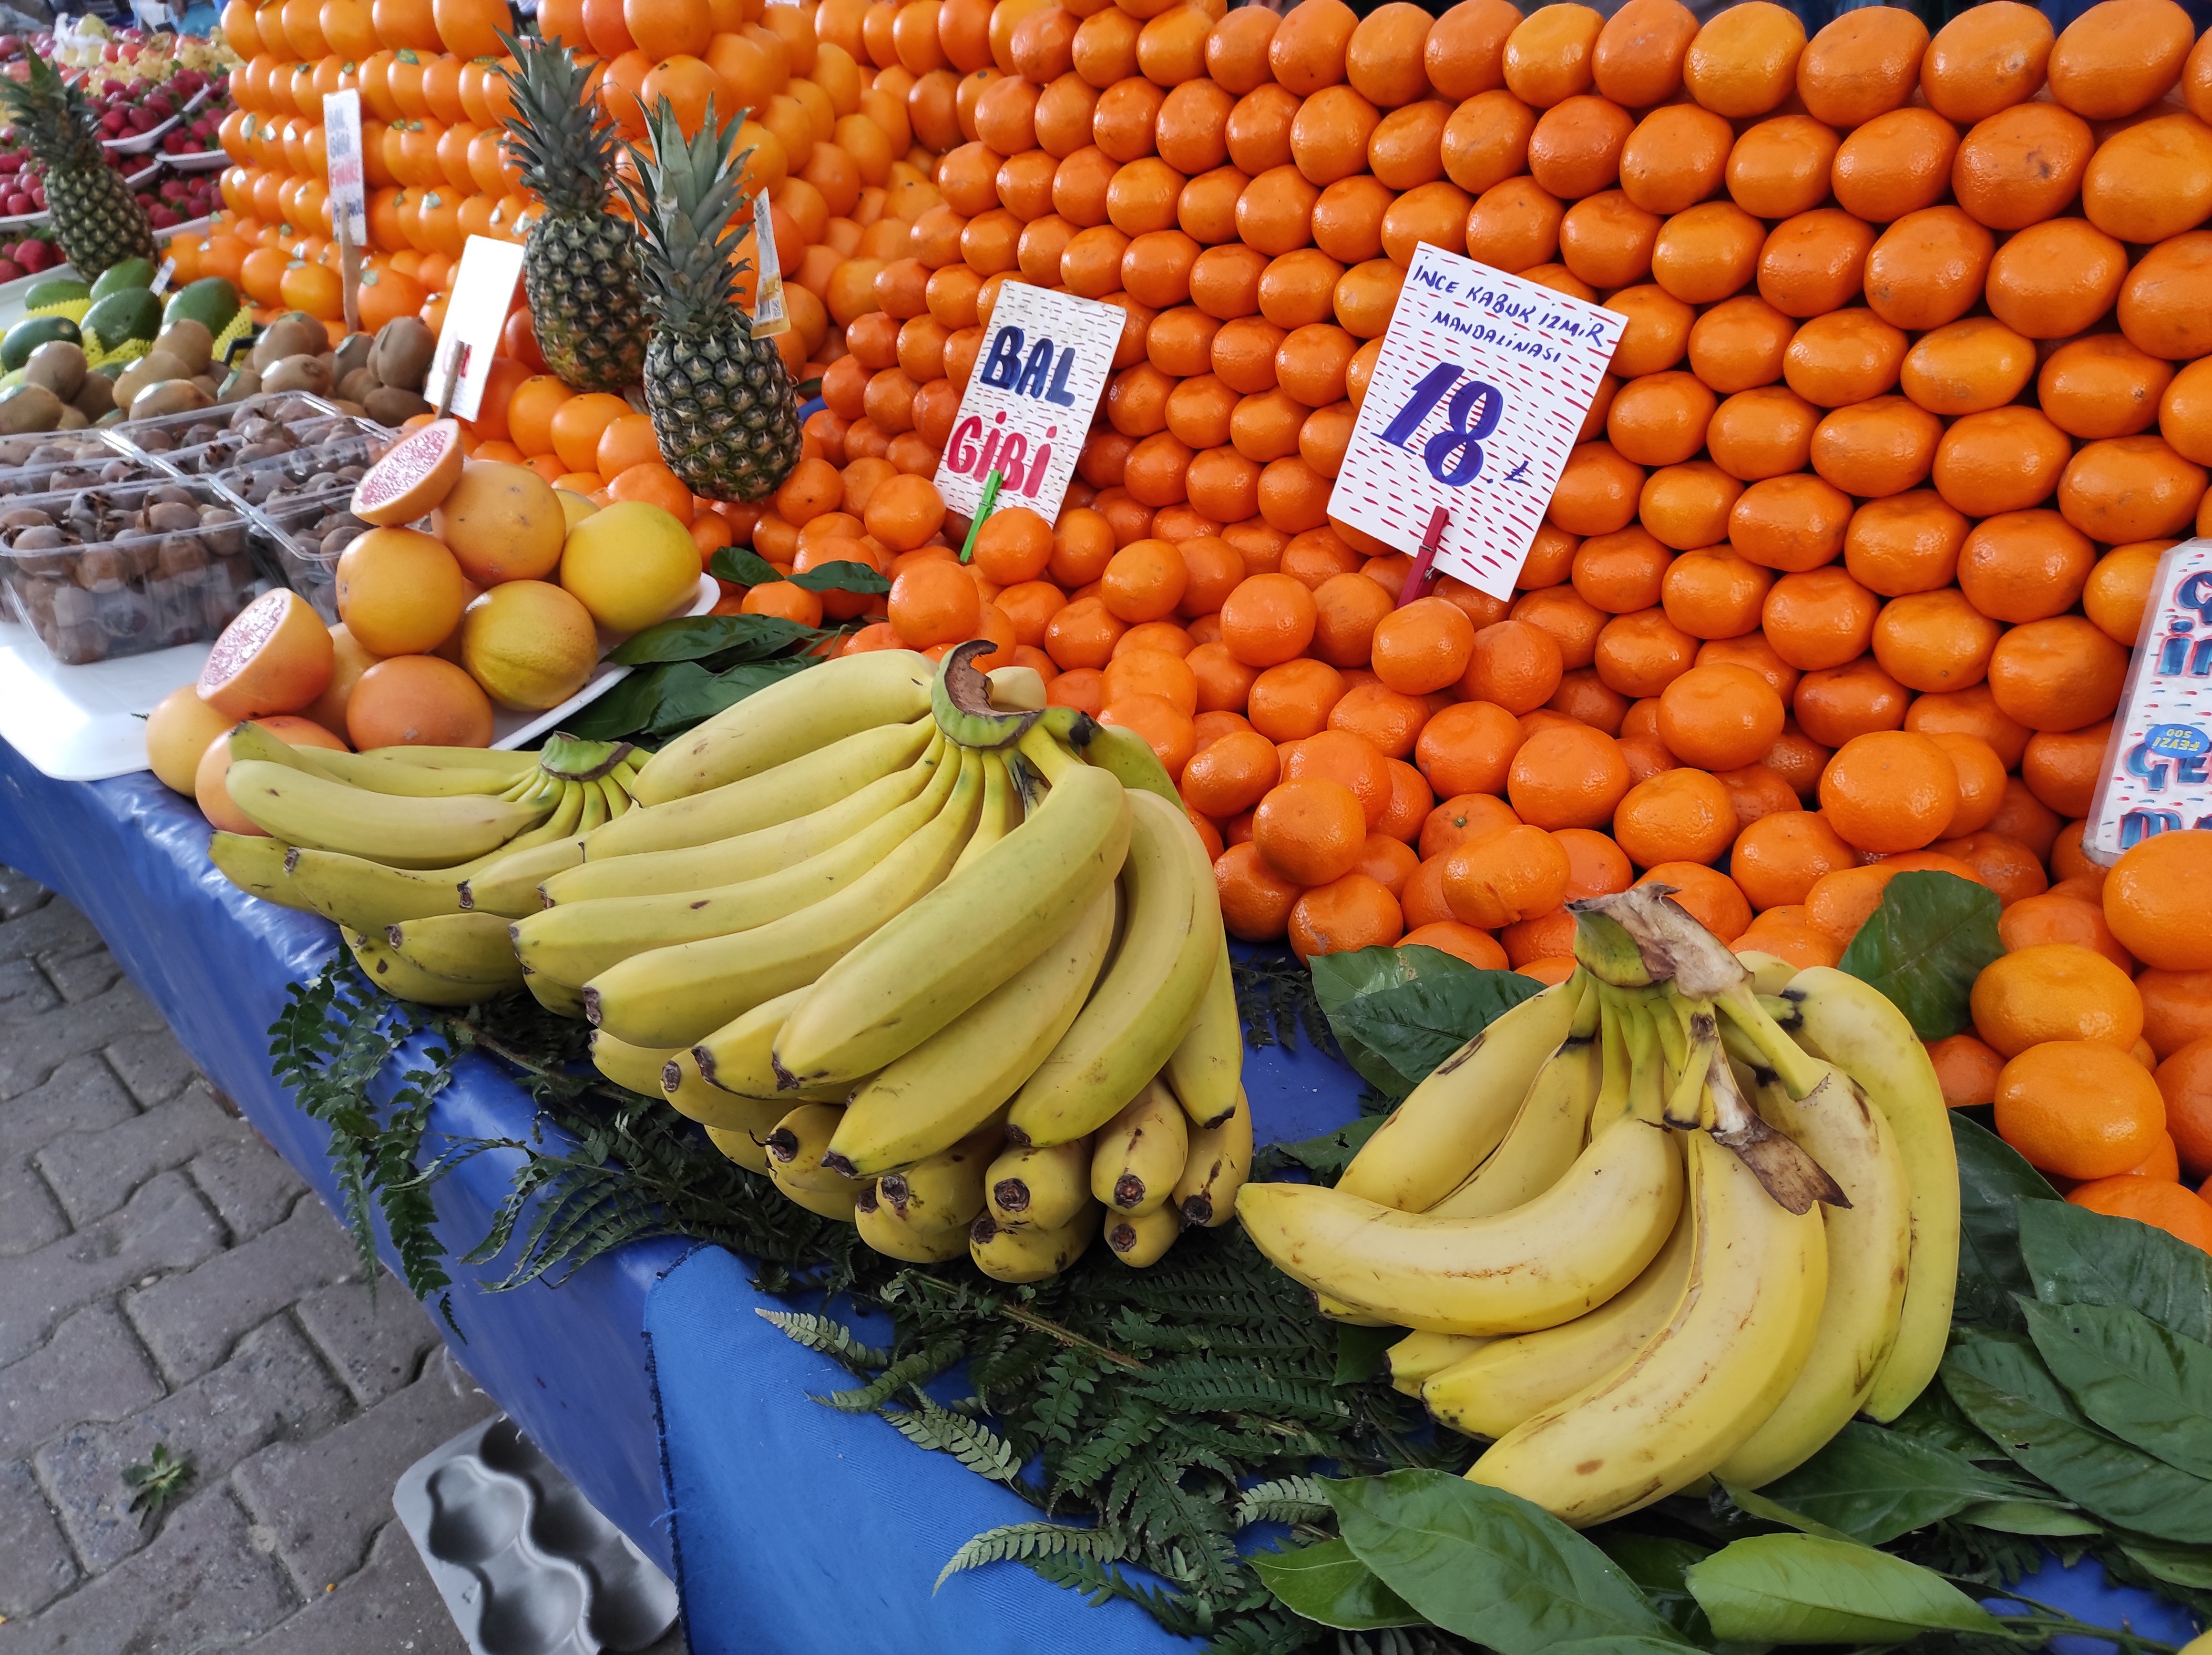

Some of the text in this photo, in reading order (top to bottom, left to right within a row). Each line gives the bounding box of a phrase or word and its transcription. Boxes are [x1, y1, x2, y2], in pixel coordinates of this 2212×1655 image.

[1412, 256, 1604, 347] İNCE KABUK İZMİR
[980, 326, 1075, 407] BAL
[2166, 728, 2193, 738] 500
